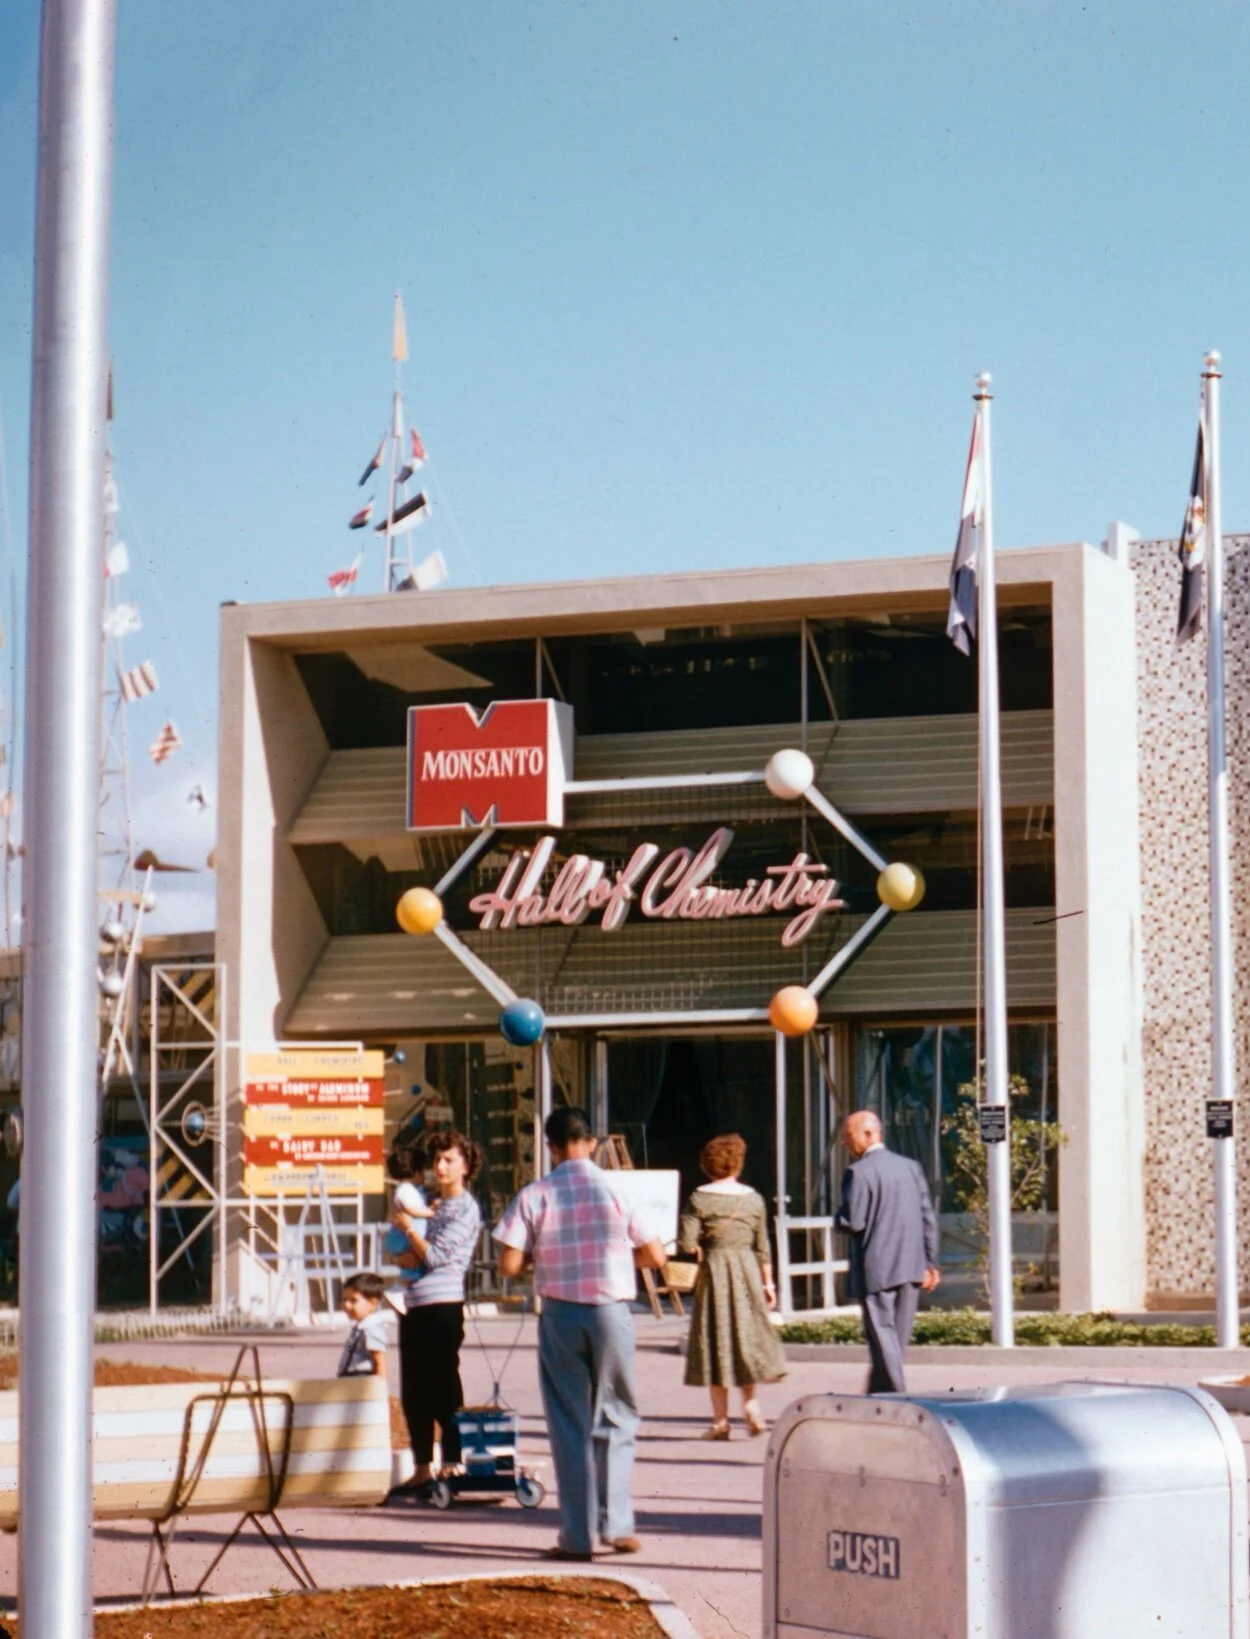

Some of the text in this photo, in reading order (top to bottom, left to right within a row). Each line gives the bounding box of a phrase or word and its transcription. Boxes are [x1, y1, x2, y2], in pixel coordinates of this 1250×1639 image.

[421, 746, 544, 782] MONSANTO
[469, 827, 846, 948] Hall of Chemistry
[828, 1531, 897, 1577] PUSH
